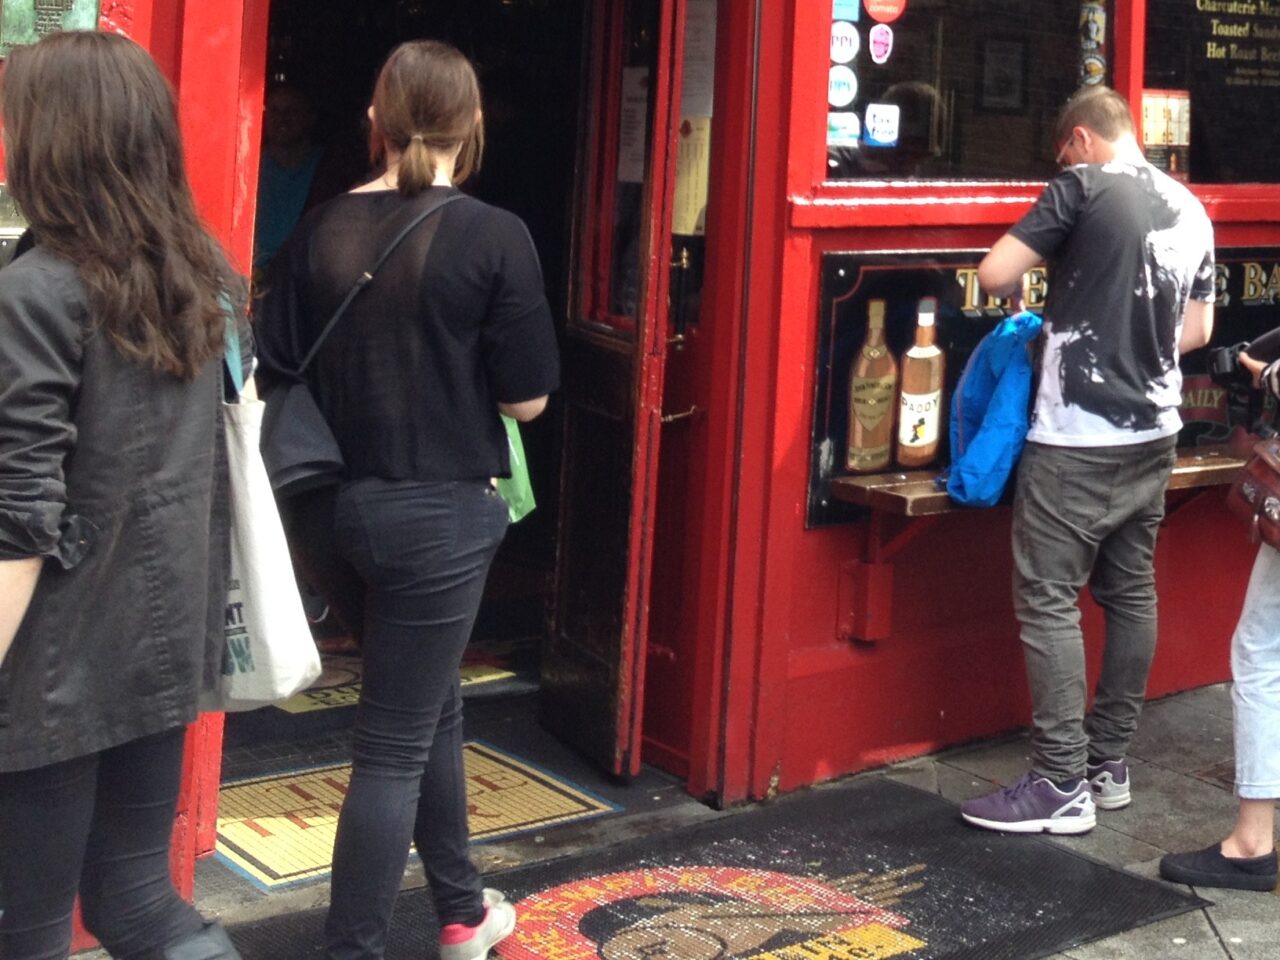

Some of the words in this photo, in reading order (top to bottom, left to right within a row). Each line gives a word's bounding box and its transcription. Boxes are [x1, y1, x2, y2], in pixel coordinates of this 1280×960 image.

[1211, 19, 1249, 37] Toasted
[1206, 42, 1226, 59] Hot
[1183, 388, 1226, 409] AILY
